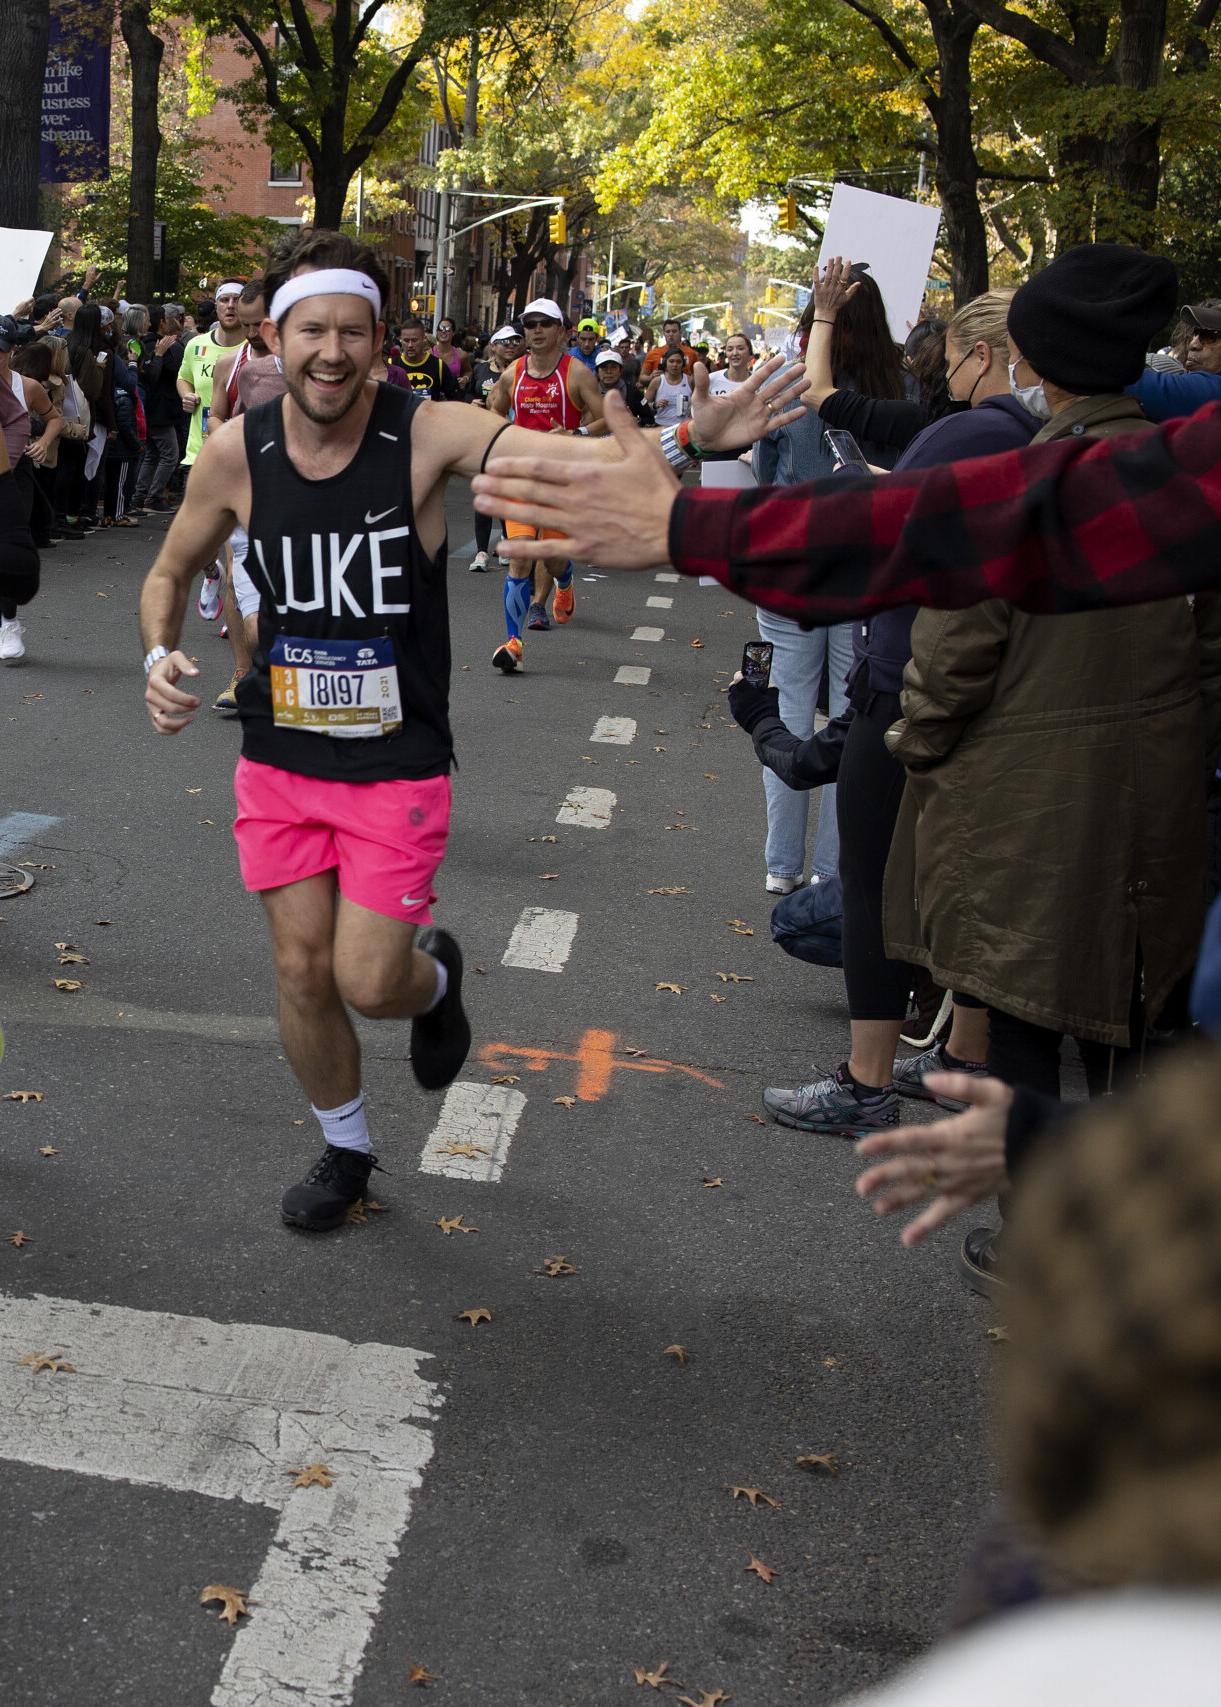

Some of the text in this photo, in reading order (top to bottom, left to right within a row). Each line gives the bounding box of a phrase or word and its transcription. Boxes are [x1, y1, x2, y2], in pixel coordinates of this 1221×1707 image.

[284, 643, 313, 664] tcs
[354, 658, 379, 667] TATA
[284, 669, 365, 706] 3 18197
[285, 688, 296, 706] C
[380, 674, 391, 699] 2021
